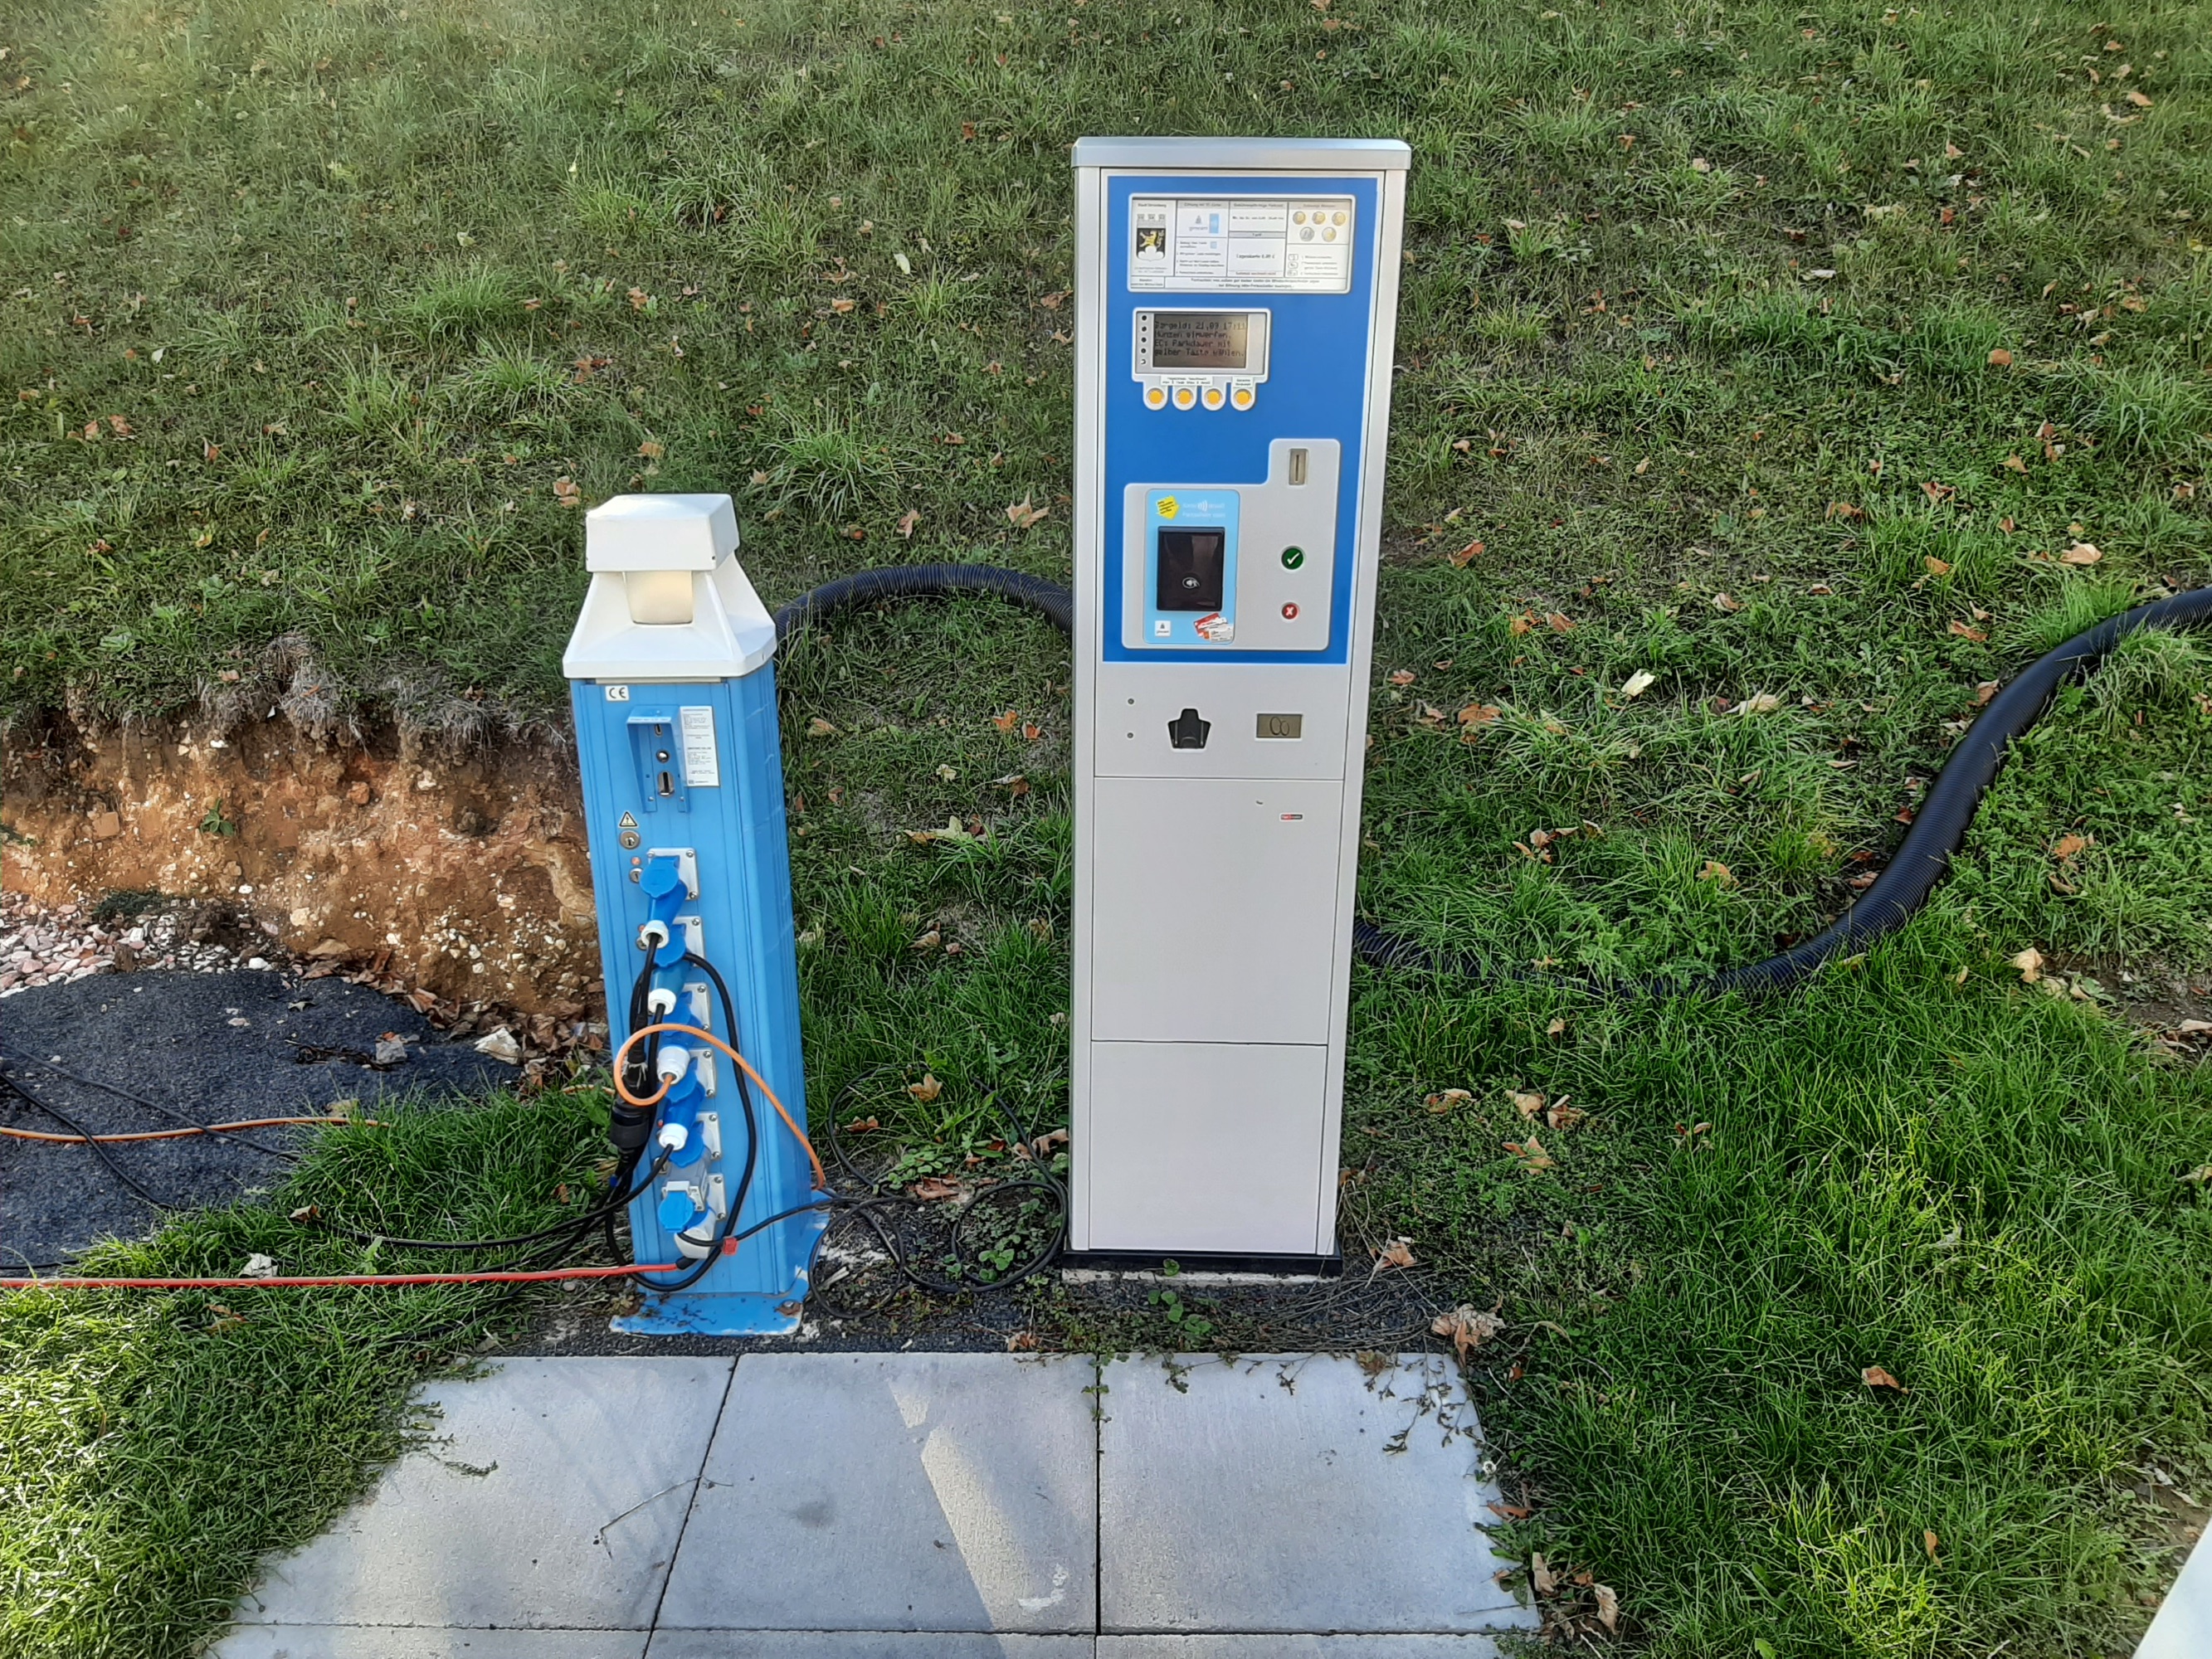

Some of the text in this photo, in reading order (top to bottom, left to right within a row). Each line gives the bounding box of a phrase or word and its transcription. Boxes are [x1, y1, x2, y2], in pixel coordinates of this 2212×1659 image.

[1172, 339, 1214, 348] Parkdauer
[1186, 348, 1209, 357] Taste
[609, 687, 626, 699] CE
